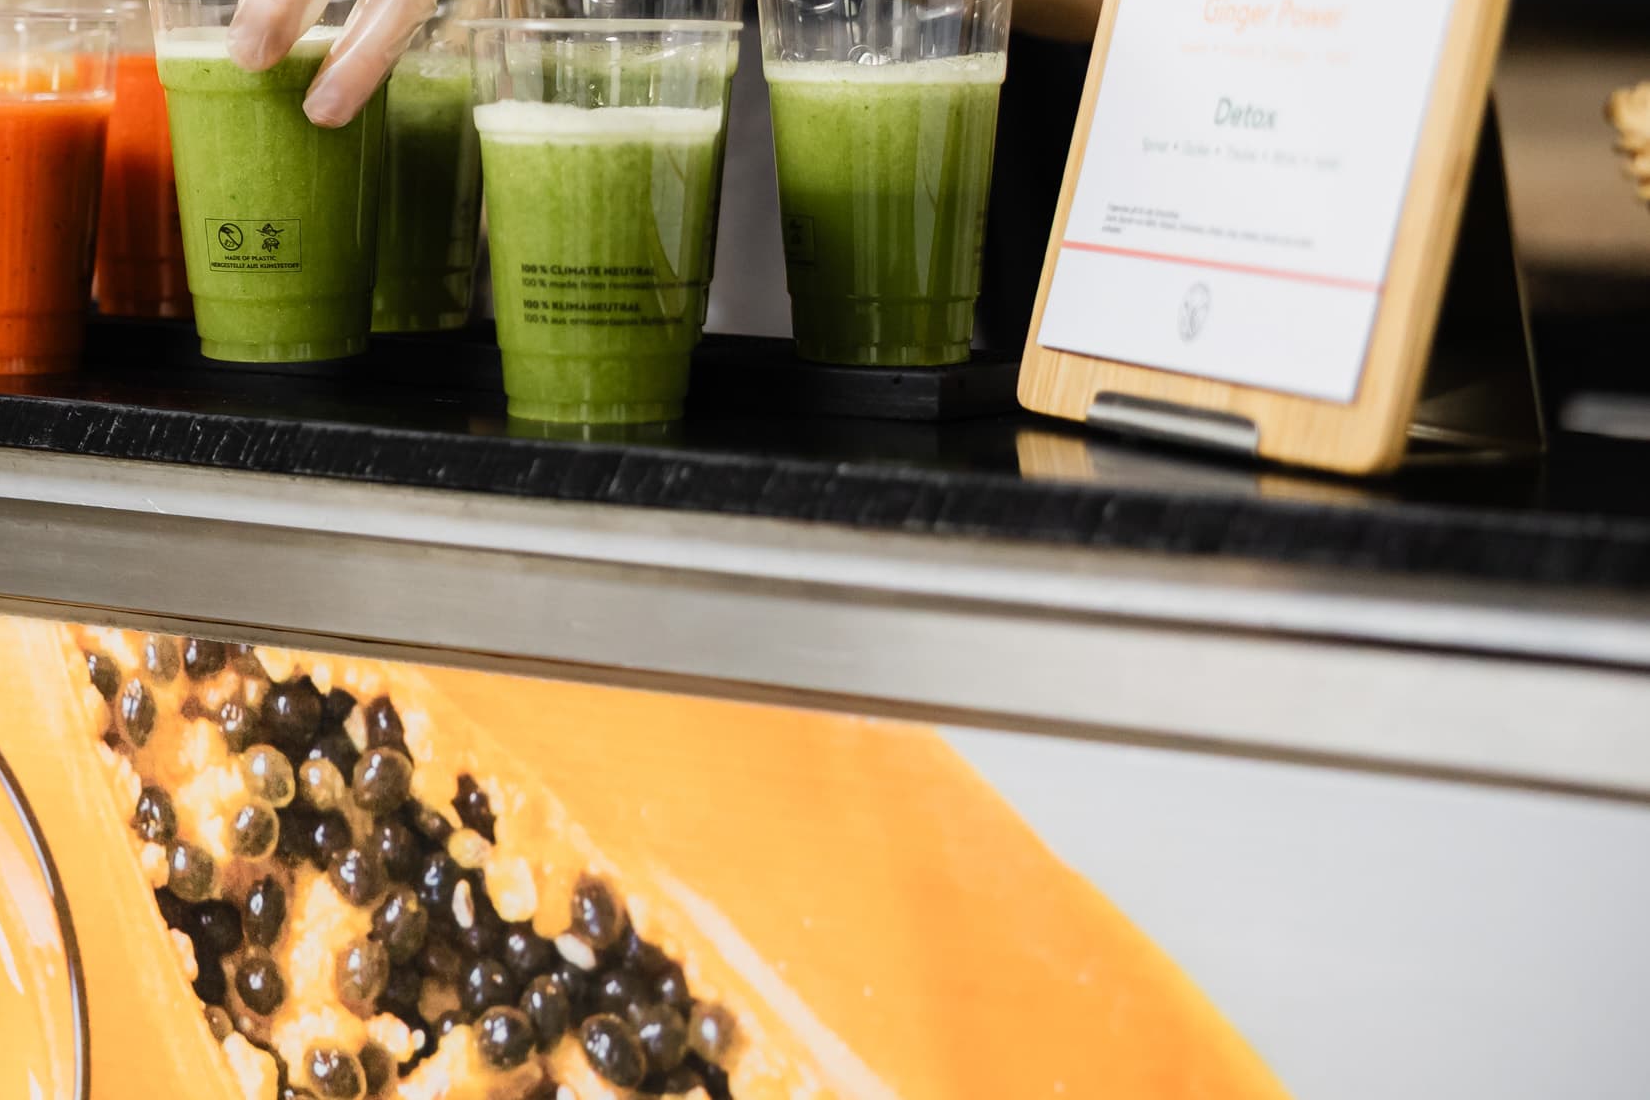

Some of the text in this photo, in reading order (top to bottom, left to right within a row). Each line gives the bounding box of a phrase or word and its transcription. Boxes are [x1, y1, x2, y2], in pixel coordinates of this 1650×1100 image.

[1212, 96, 1277, 130] Detox
[521, 264, 654, 277] 100 % CLIMATE NEUTRAL
[522, 278, 536, 287] 100
[523, 300, 640, 312] 100 % KLIMANEUTRAL
[524, 314, 538, 324] 100
